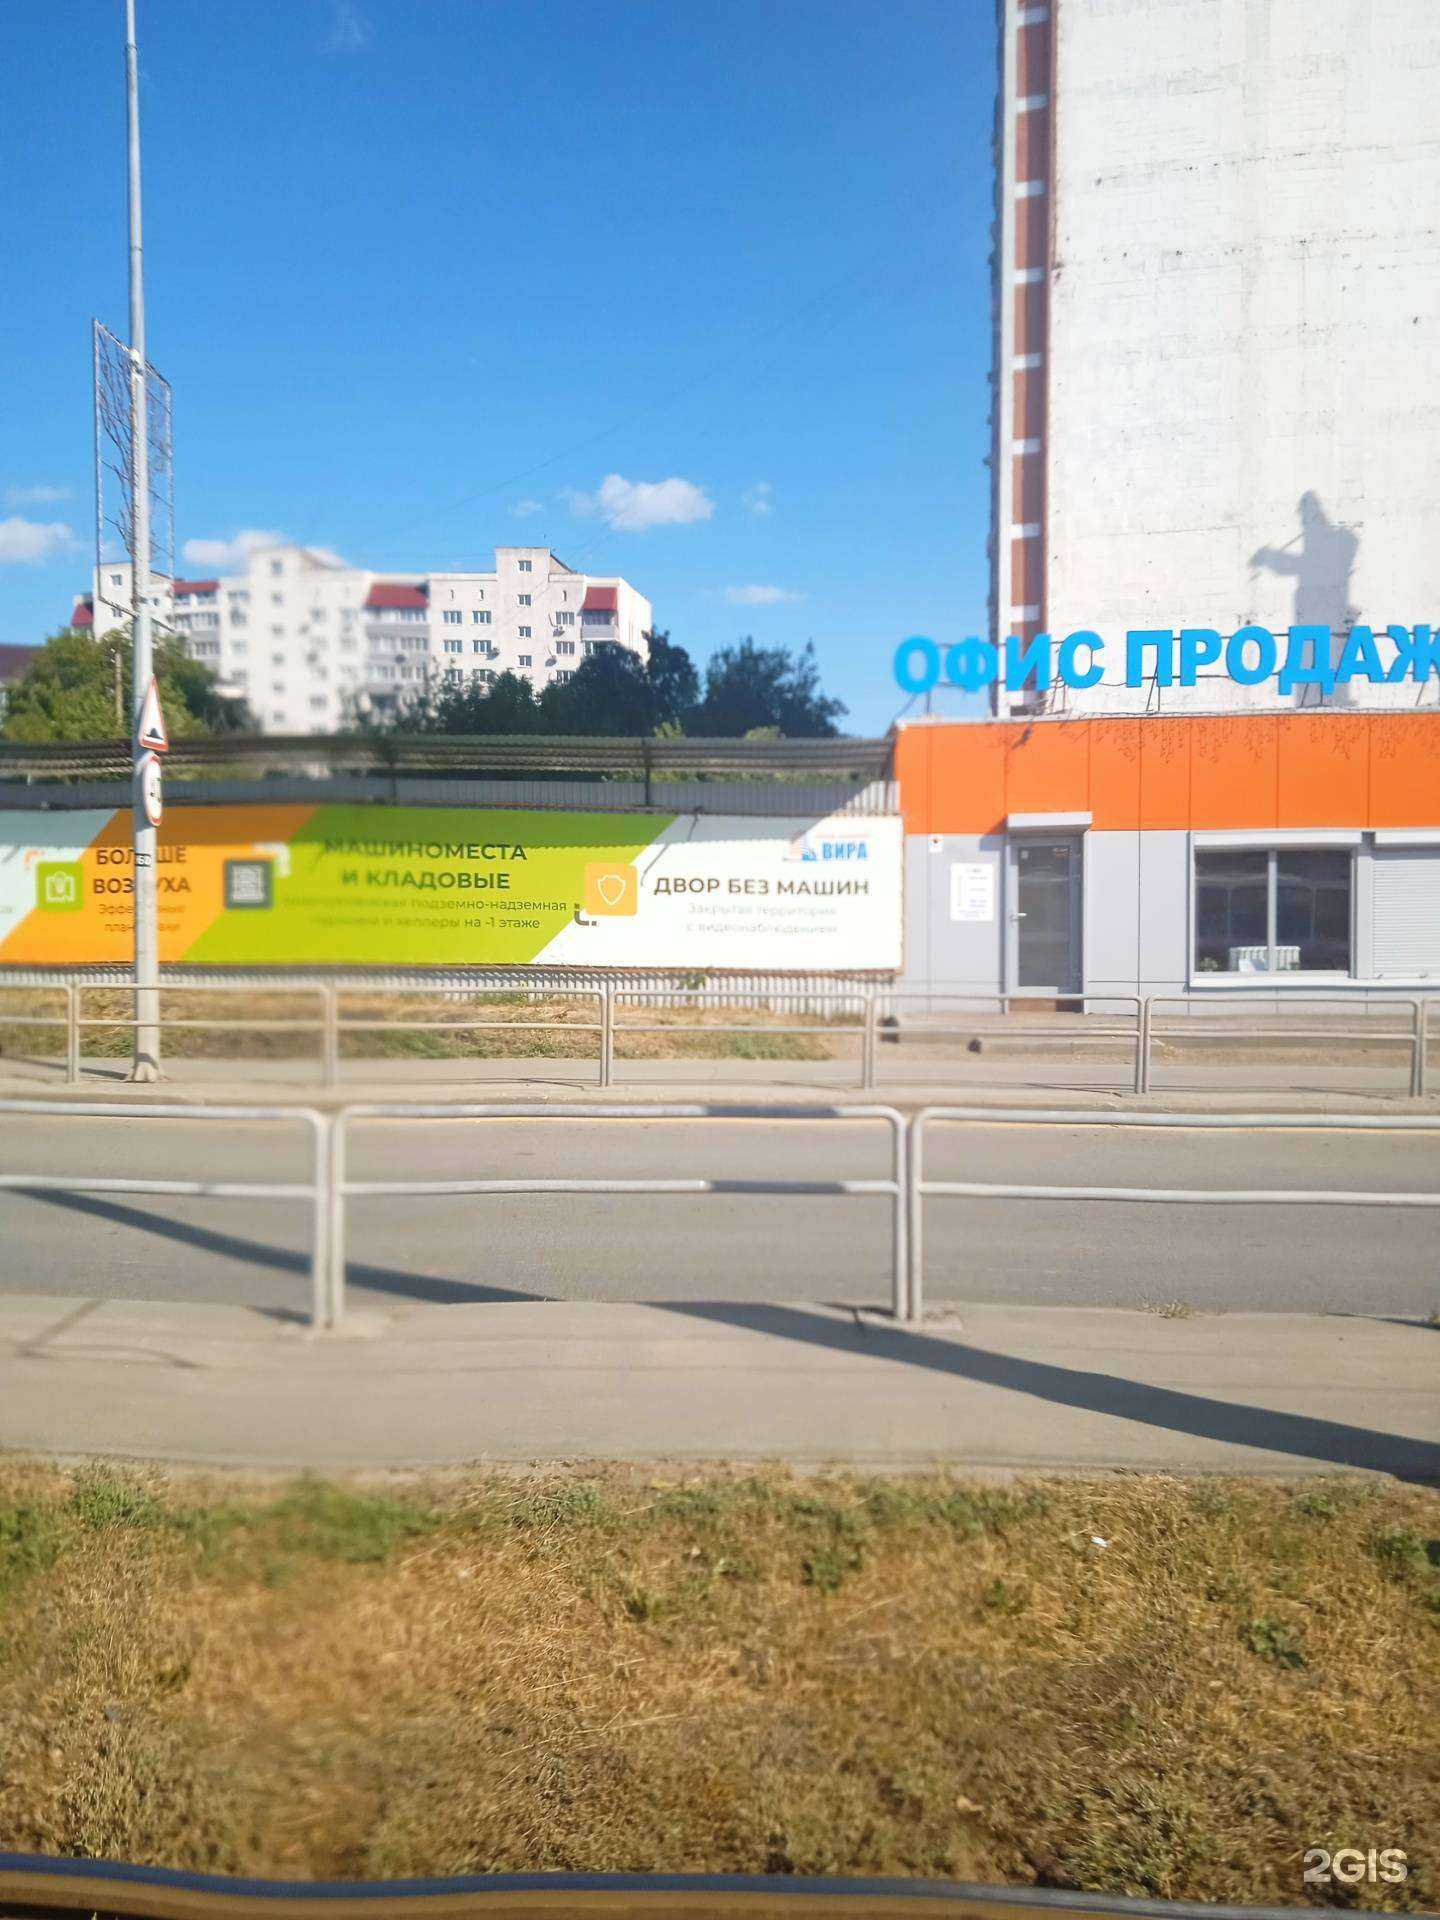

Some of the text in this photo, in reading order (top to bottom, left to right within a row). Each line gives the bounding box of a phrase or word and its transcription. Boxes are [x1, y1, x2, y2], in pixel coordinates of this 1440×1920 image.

[893, 624, 1440, 695] ОФИС ПРОДАЖ
[96, 846, 187, 865] БОЛШЕ
[324, 839, 528, 861] МАШИНОМЕСТА
[822, 842, 867, 860] ВИРА
[93, 877, 192, 894] ВОЗХА
[342, 870, 511, 890] И КЛАДОВЫЕ
[654, 878, 869, 895] ДВОР БЕЗ МАШИН
[464, 917, 481, 928] на
[499, 918, 541, 929] этаже
